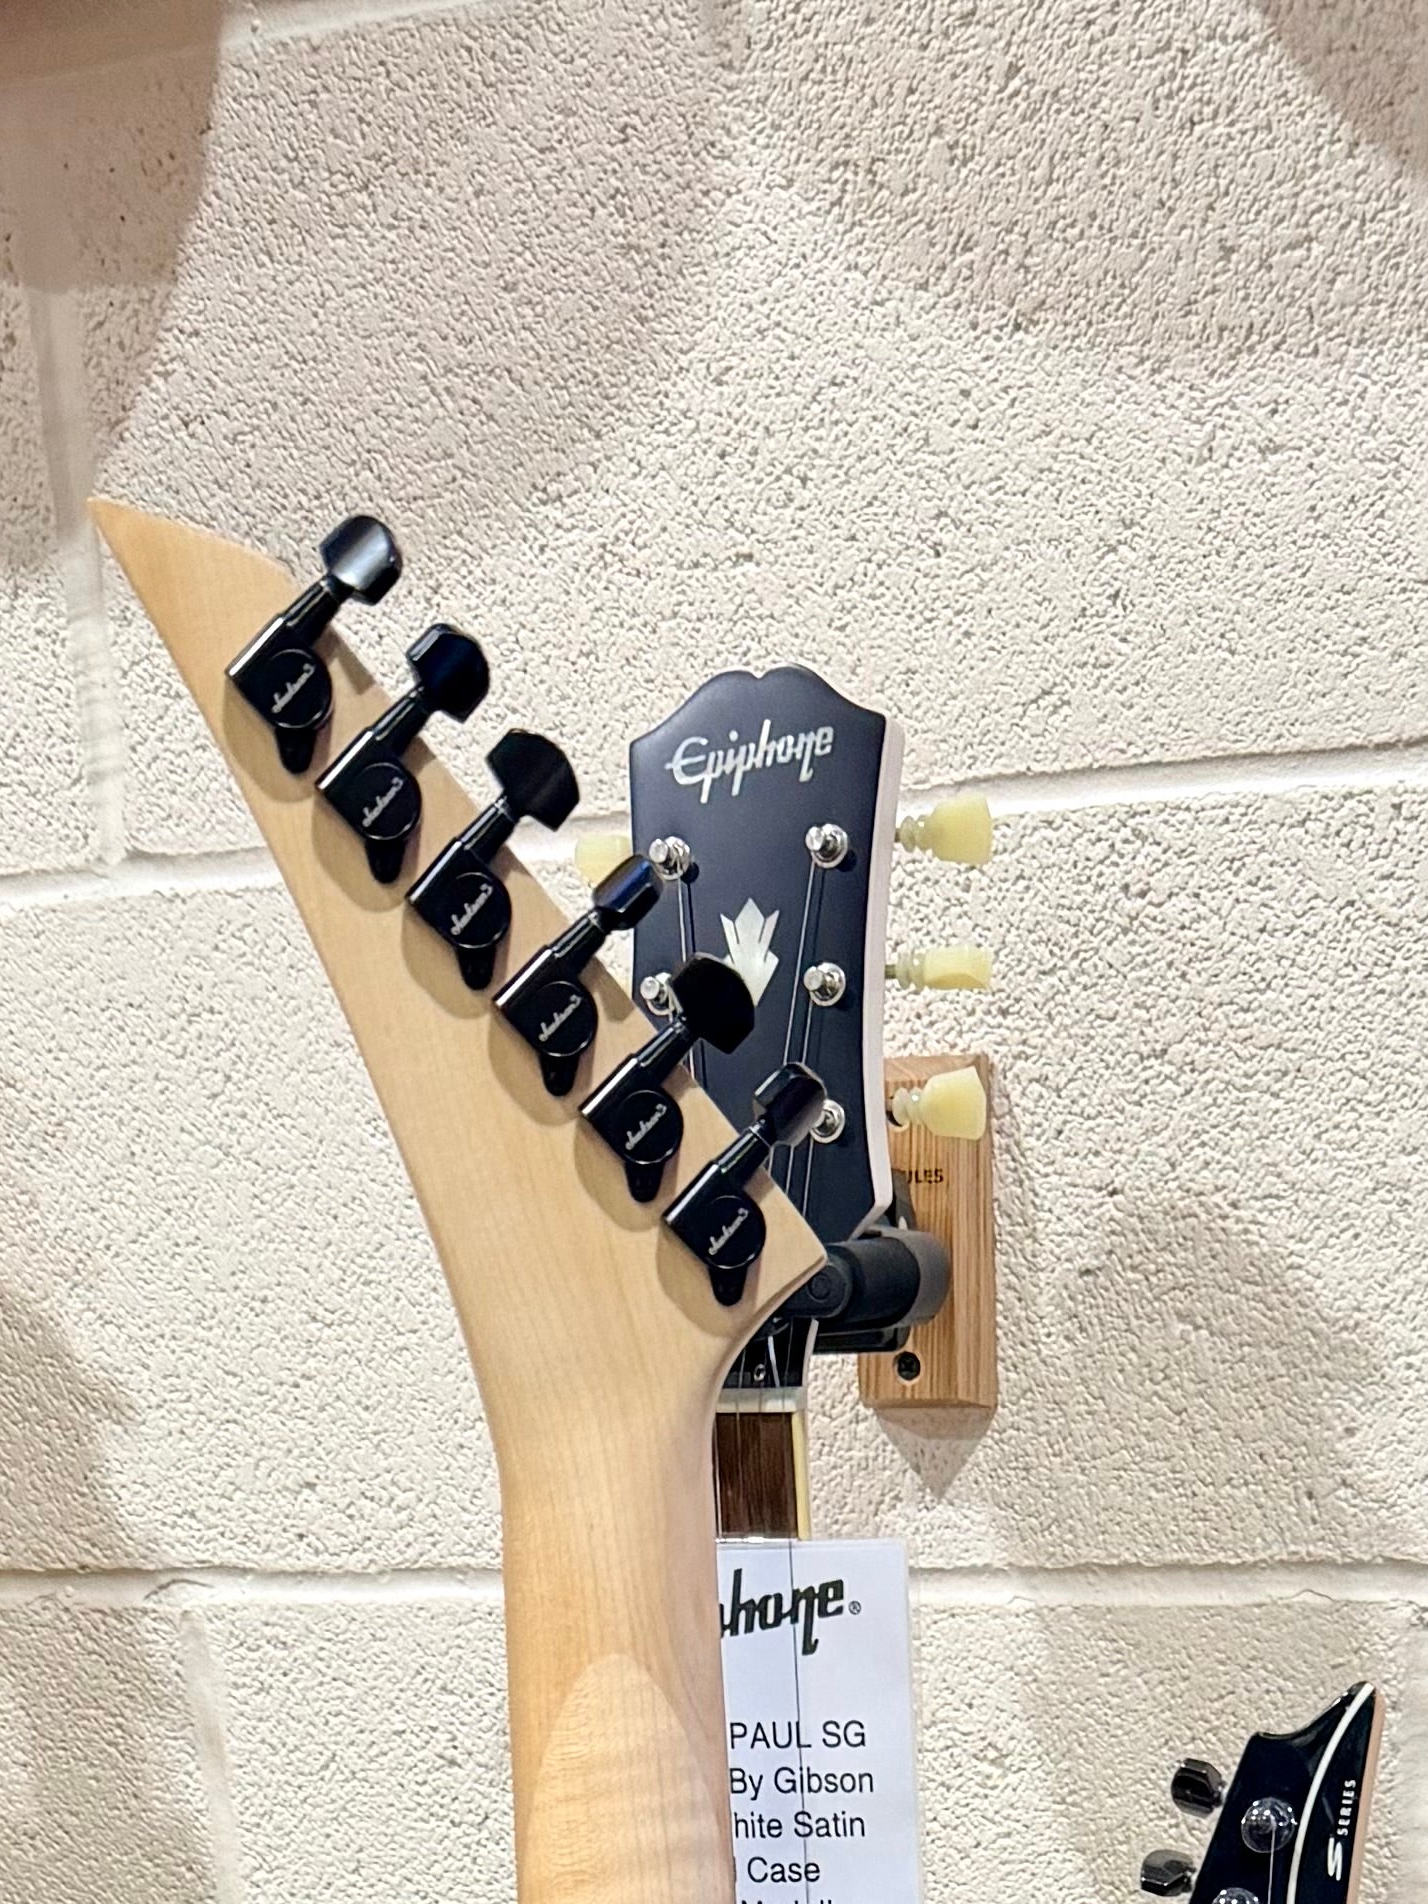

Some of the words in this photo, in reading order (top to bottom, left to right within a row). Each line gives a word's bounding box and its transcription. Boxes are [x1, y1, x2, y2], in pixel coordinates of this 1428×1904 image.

[664, 719, 834, 804] Epiphone
[729, 1721, 812, 1749] PAUL
[822, 1720, 867, 1748] SG
[729, 1768, 764, 1800] By
[774, 1766, 874, 1795] Gibson
[733, 1812, 782, 1839] hite
[794, 1811, 866, 1838] Satin
[1327, 1837, 1343, 1881] S
[1336, 1780, 1356, 1836] SERIES
[747, 1857, 821, 1883] Case
